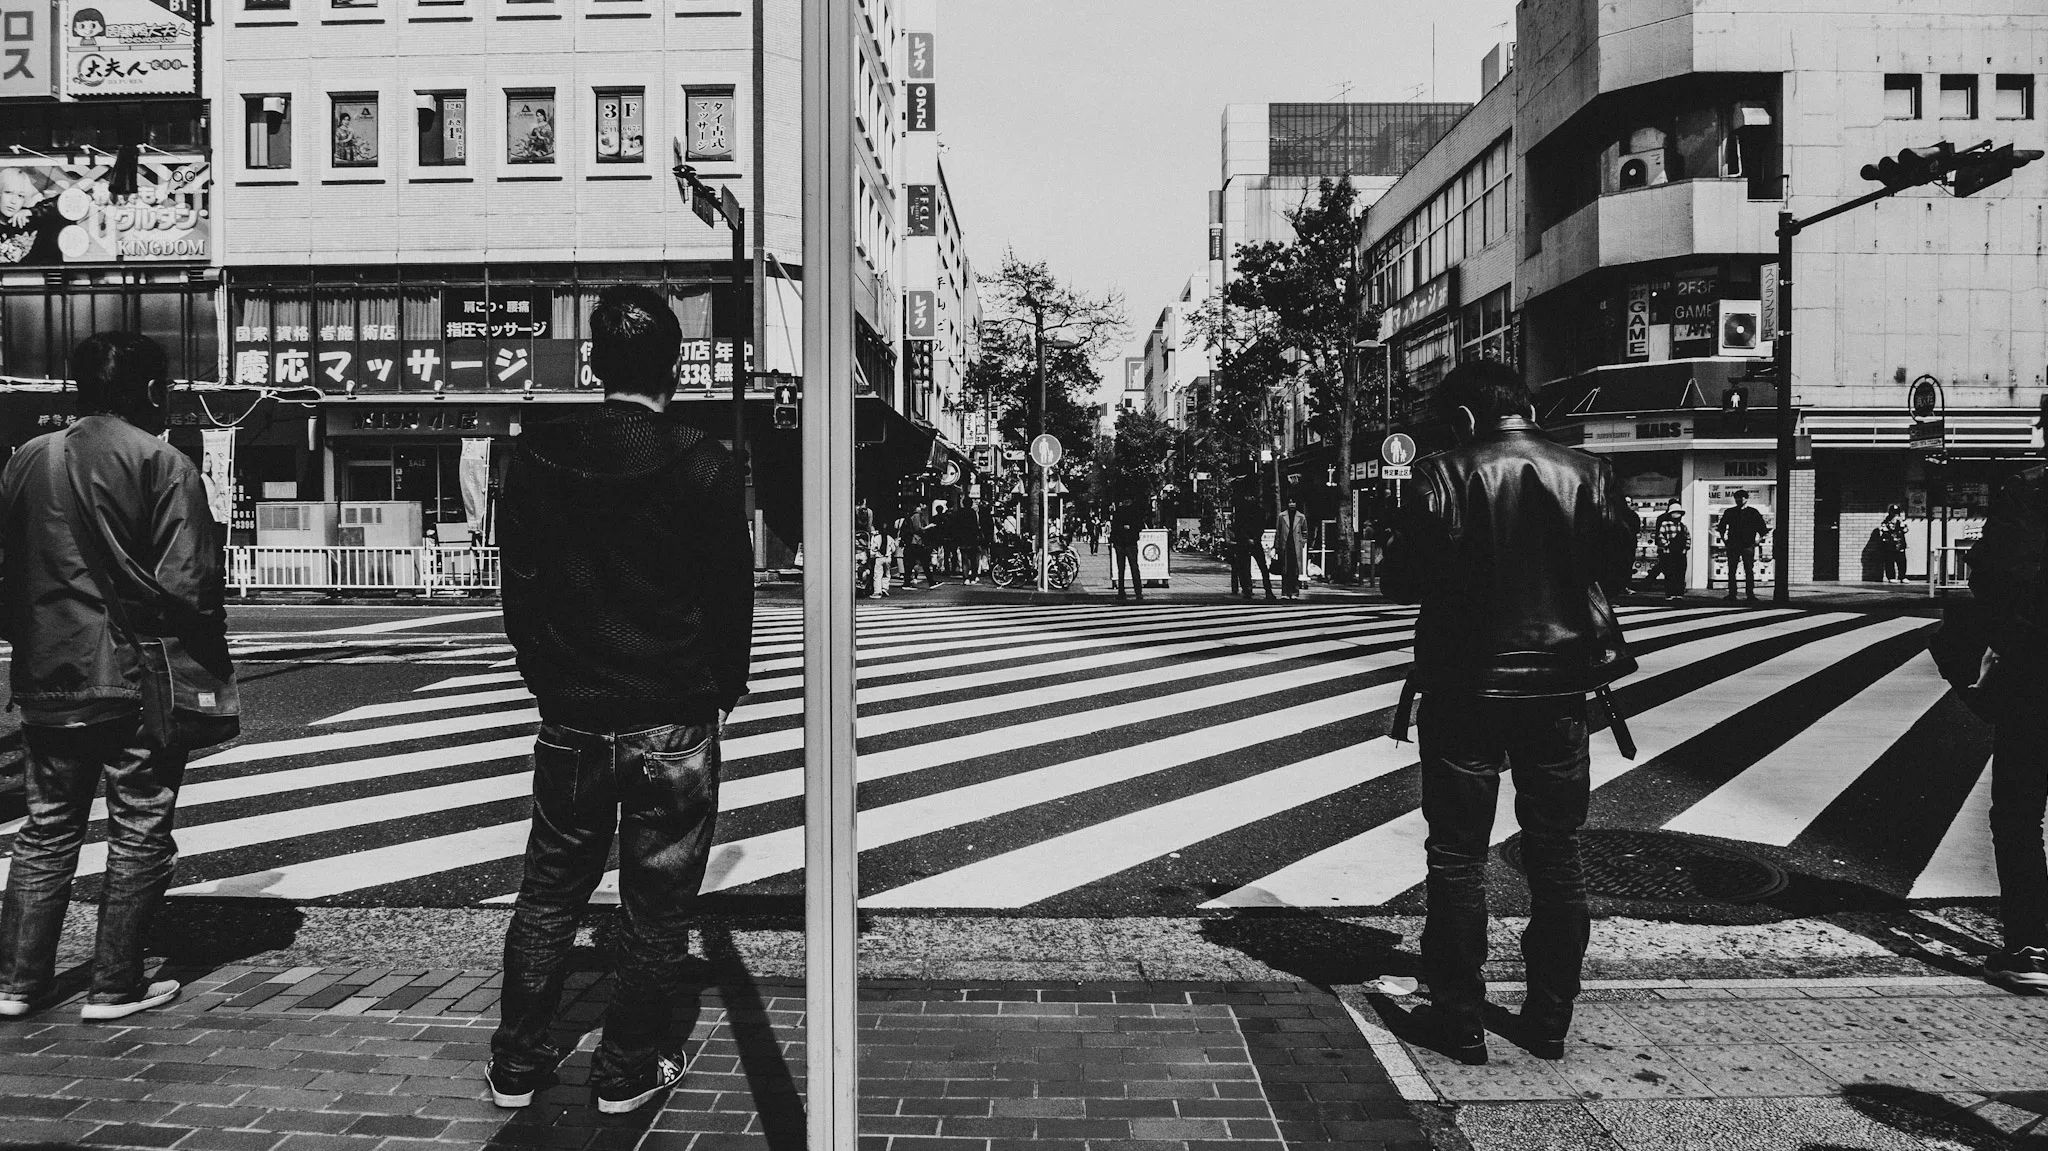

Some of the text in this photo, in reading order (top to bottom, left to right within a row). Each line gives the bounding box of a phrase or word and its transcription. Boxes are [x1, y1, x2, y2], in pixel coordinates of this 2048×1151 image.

[85, 57, 149, 78] 大夫人
[914, 37, 926, 71] レイク
[697, 102, 708, 150] マッサージ
[712, 102, 724, 148] タイ古式
[117, 240, 205, 255] KINGDOM
[915, 295, 926, 329] レイク
[1764, 268, 1774, 338] スクランブル式
[236, 325, 396, 342] 国家資格者施術店
[446, 321, 547, 338] 指圧マッサージ
[1630, 301, 1646, 354] GAME
[235, 348, 528, 384] 慶応マッサージ
[1636, 422, 1681, 439] MARS
[408, 459, 427, 467] SALE
[1724, 462, 1768, 476] MARS
